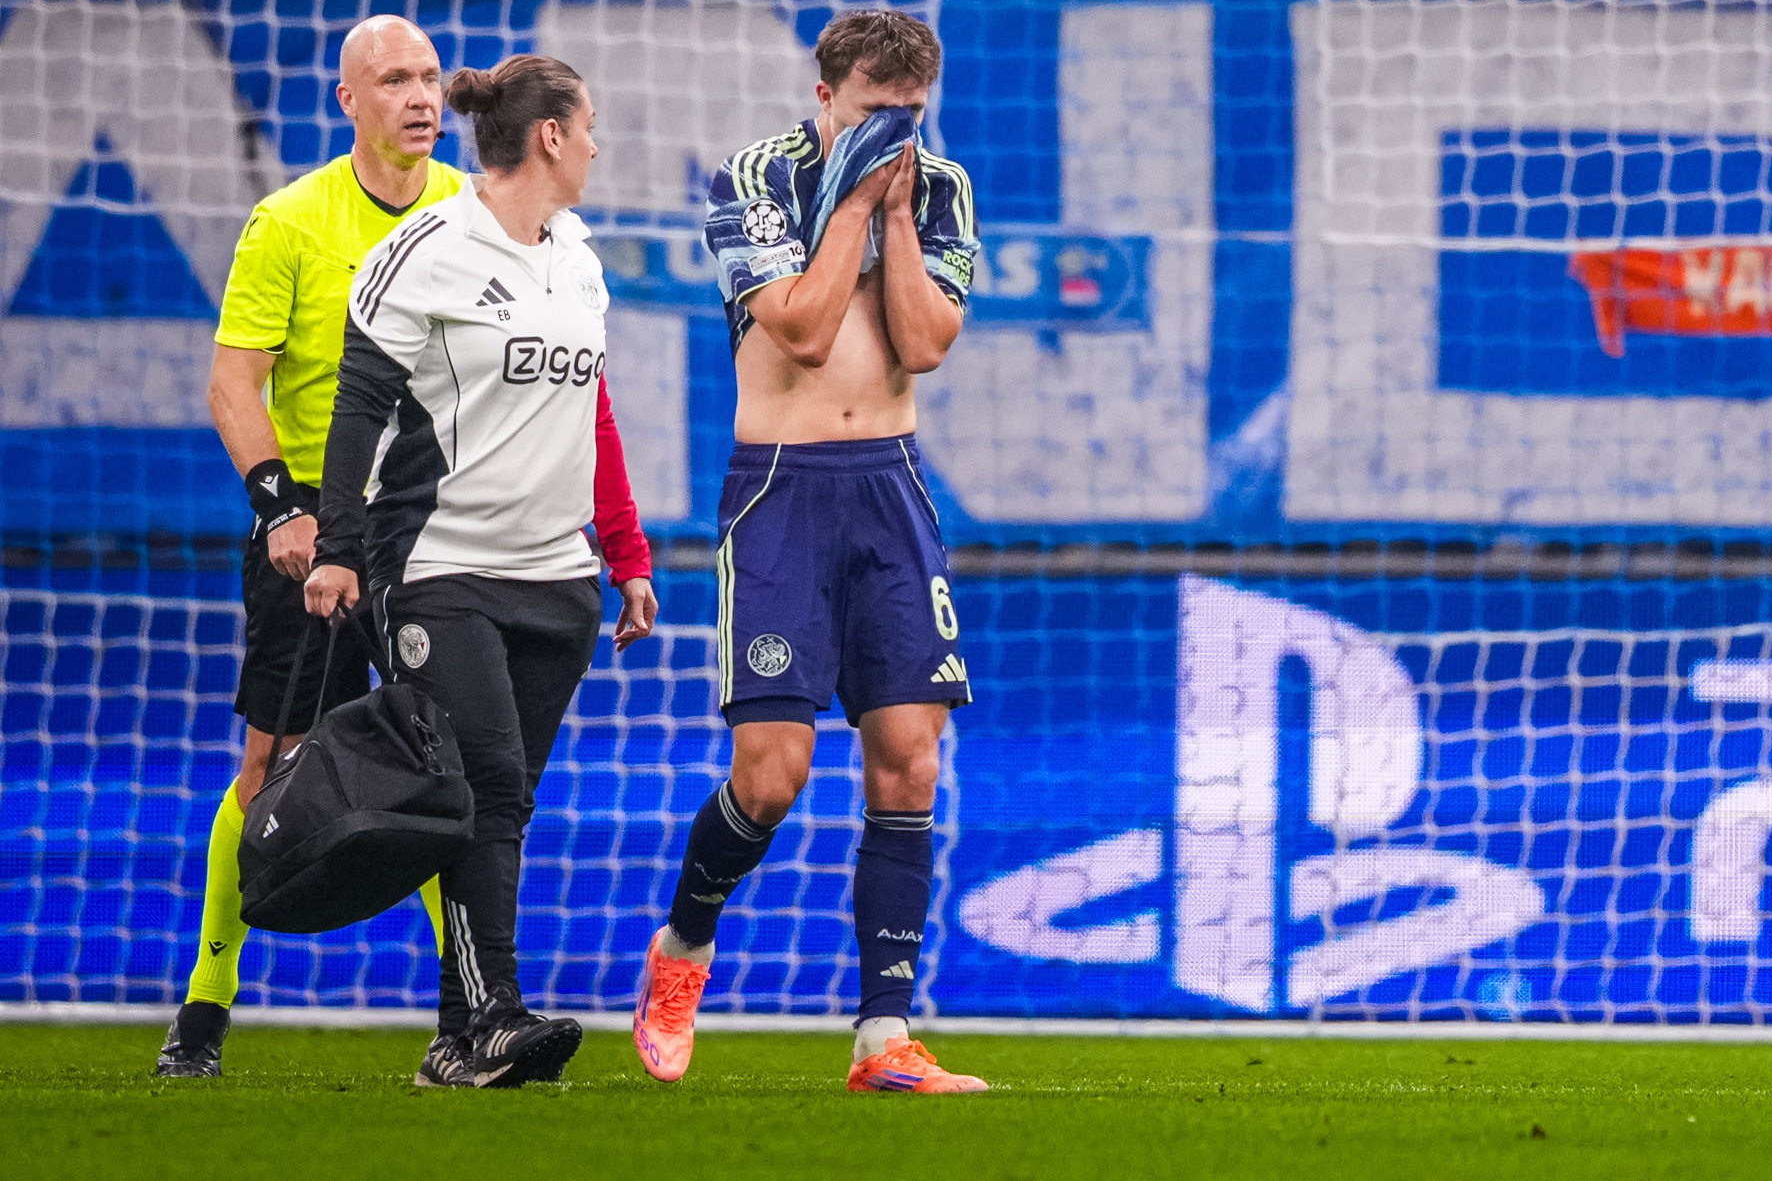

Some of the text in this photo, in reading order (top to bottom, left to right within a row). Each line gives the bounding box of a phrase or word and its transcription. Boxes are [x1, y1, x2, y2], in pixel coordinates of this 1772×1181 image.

[943, 250, 973, 273] ROCK
[498, 309, 511, 321] EB
[930, 575, 958, 640] 6
[877, 928, 924, 943] AJAX
